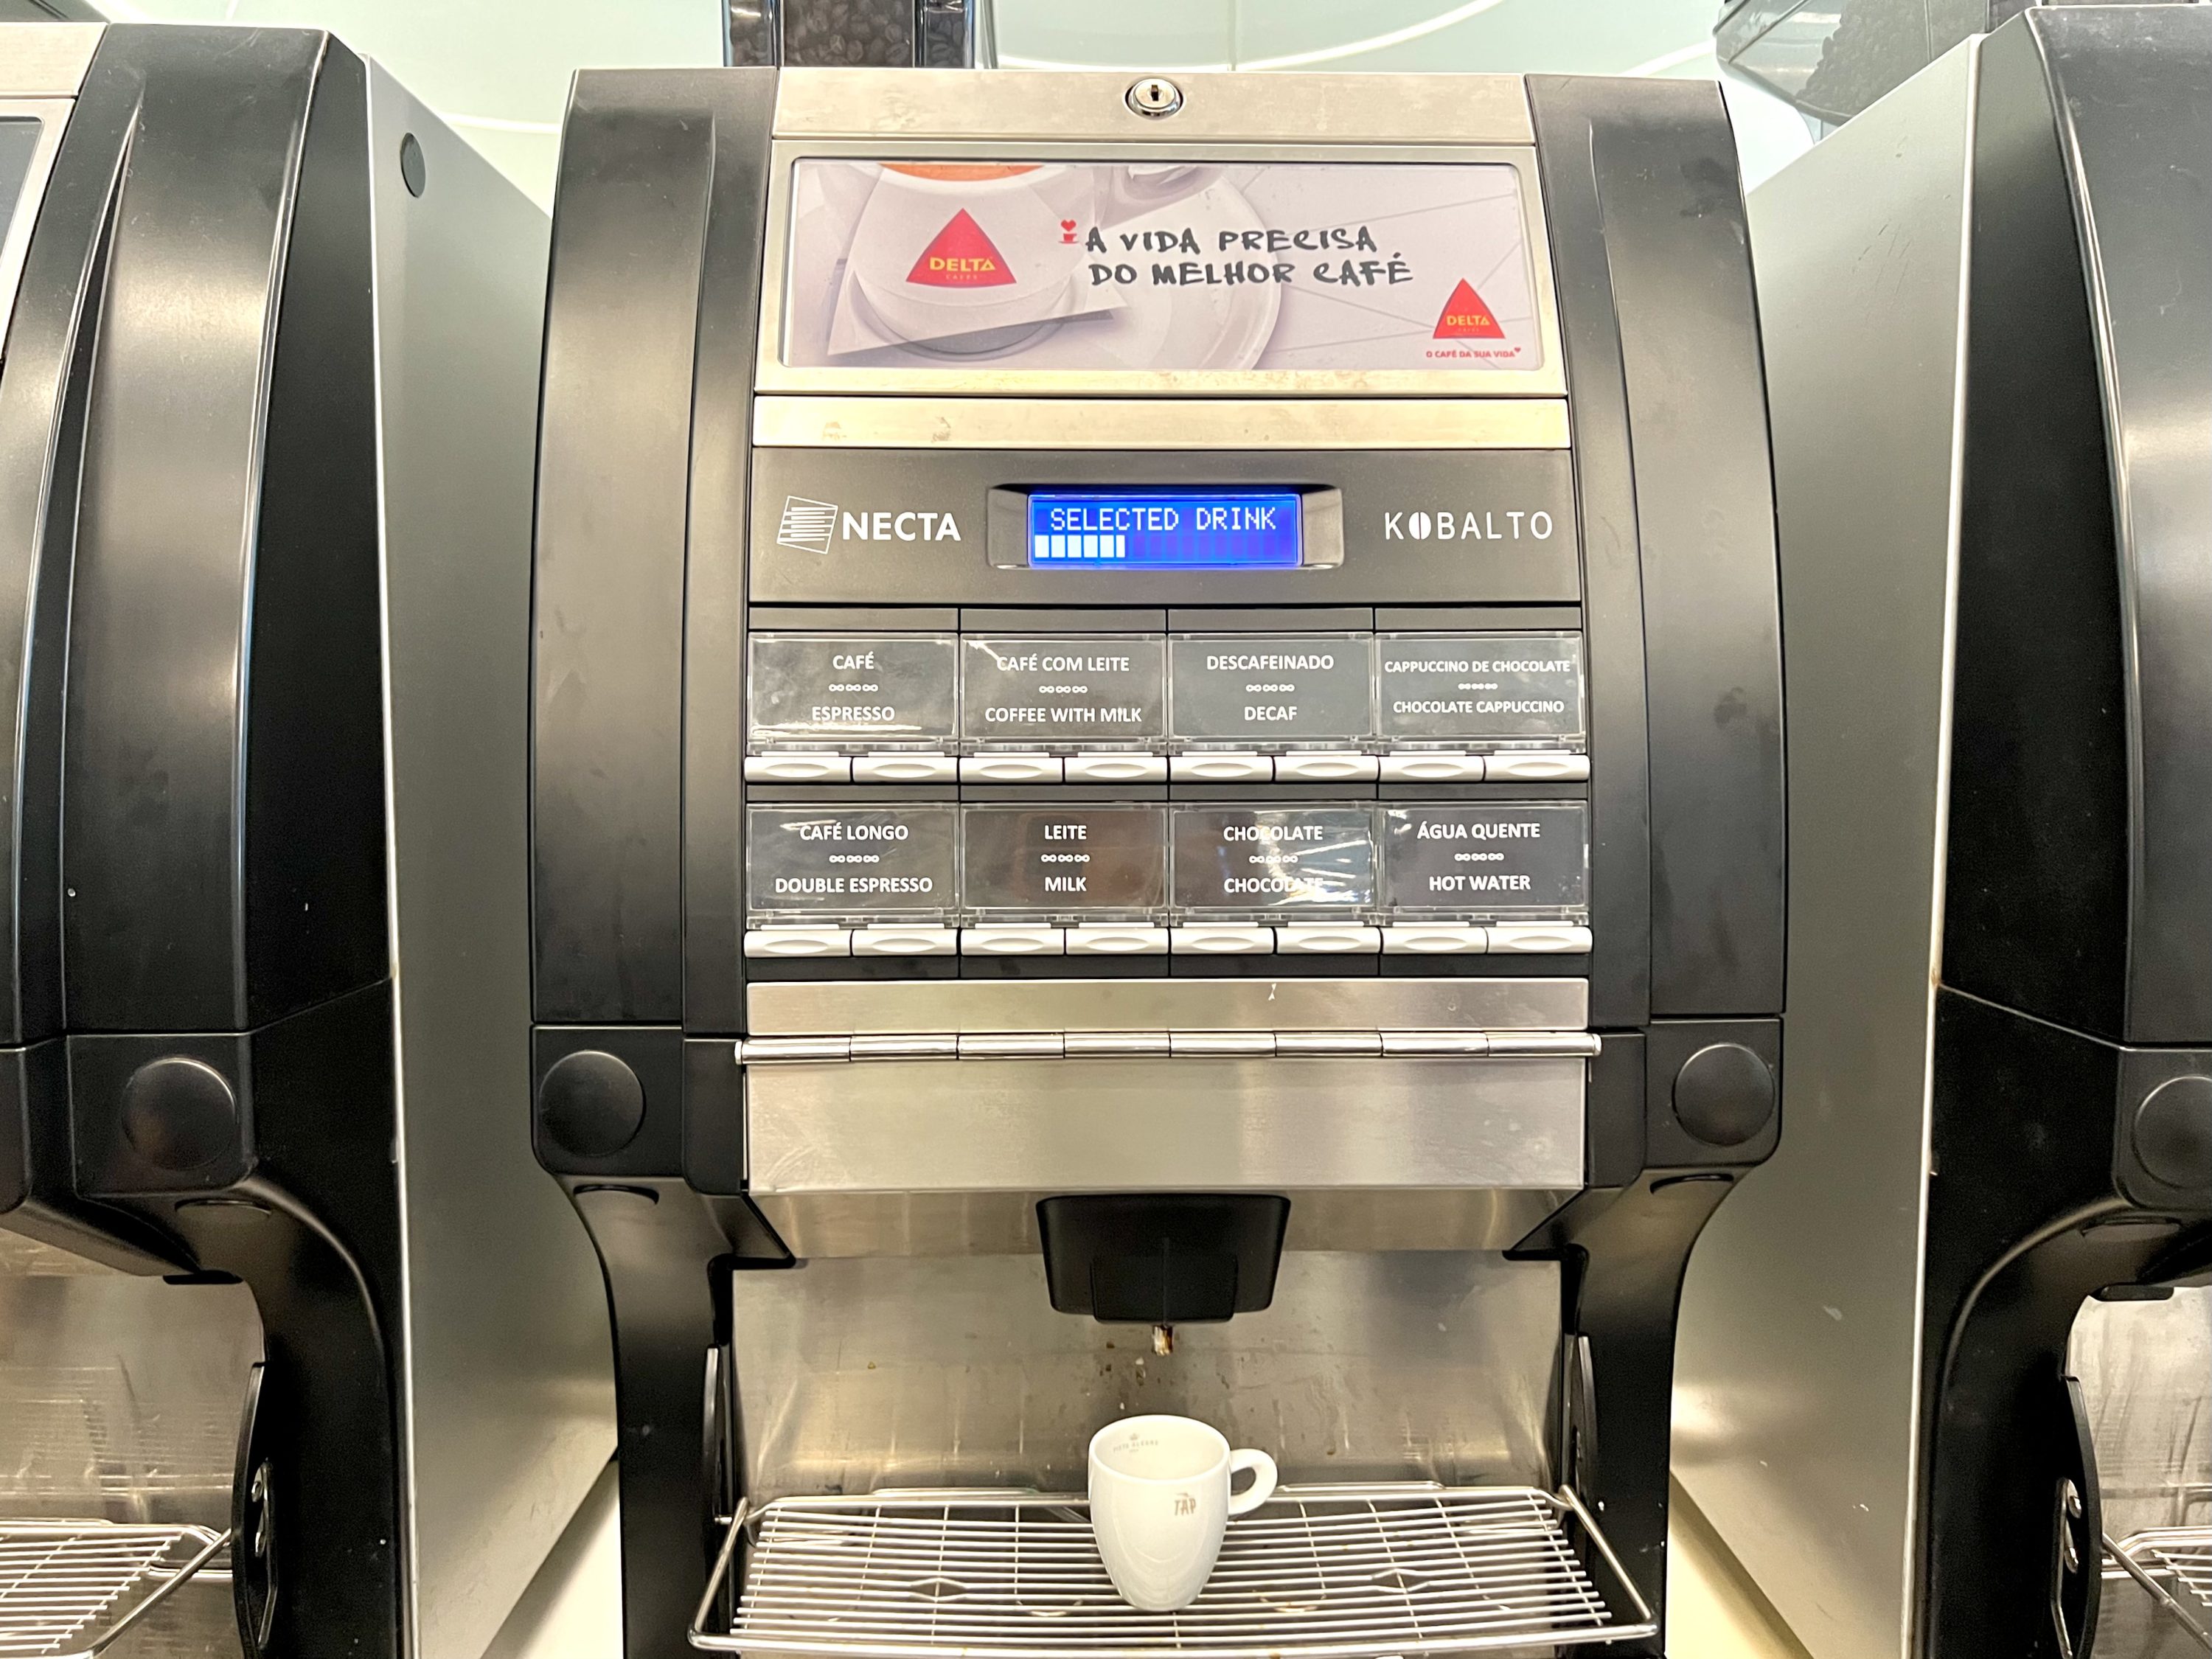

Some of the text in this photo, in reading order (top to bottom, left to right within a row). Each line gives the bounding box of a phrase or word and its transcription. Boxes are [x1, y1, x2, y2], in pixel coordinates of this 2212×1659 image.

[1085, 225, 1378, 255] A VIDA PRECISA
[929, 256, 996, 272] DELTA
[1089, 252, 1413, 286] DO MELHOR CAFÉ
[1446, 314, 1491, 326] DELTA
[1425, 348, 1515, 358] O CAFÉ DA SUA VIDA
[842, 510, 962, 543] NECTA
[1049, 507, 1277, 531] SELECTED DRINK
[1383, 510, 1554, 540] KOBALTO
[832, 651, 875, 670] CAFÉ
[996, 653, 1130, 672] CAFÉ COM LEITE
[1206, 654, 1335, 671] DESCAFEINADO
[1384, 660, 1571, 673] CAPPUCCINO DE CHOCOLATE
[811, 706, 896, 722] ESPRESSO
[985, 706, 1142, 723] COFFEE WITH MILK
[1243, 705, 1298, 721] DECAF
[1392, 700, 1565, 714] CHOCOLATE CAPPUCCINO
[799, 822, 909, 841] CAFÉ LONGO
[1044, 824, 1087, 841] LEITE
[1223, 825, 1324, 841] CHOCOLATE
[1416, 820, 1540, 841] ÁGUA QUENTE
[775, 877, 933, 894] DOUBLE ESPRESSO
[1044, 876, 1087, 892] MILK
[1223, 877, 1324, 894] CHOCOLATE
[1429, 874, 1531, 891] HOT WATER
[1175, 1498, 1196, 1516] TAP
